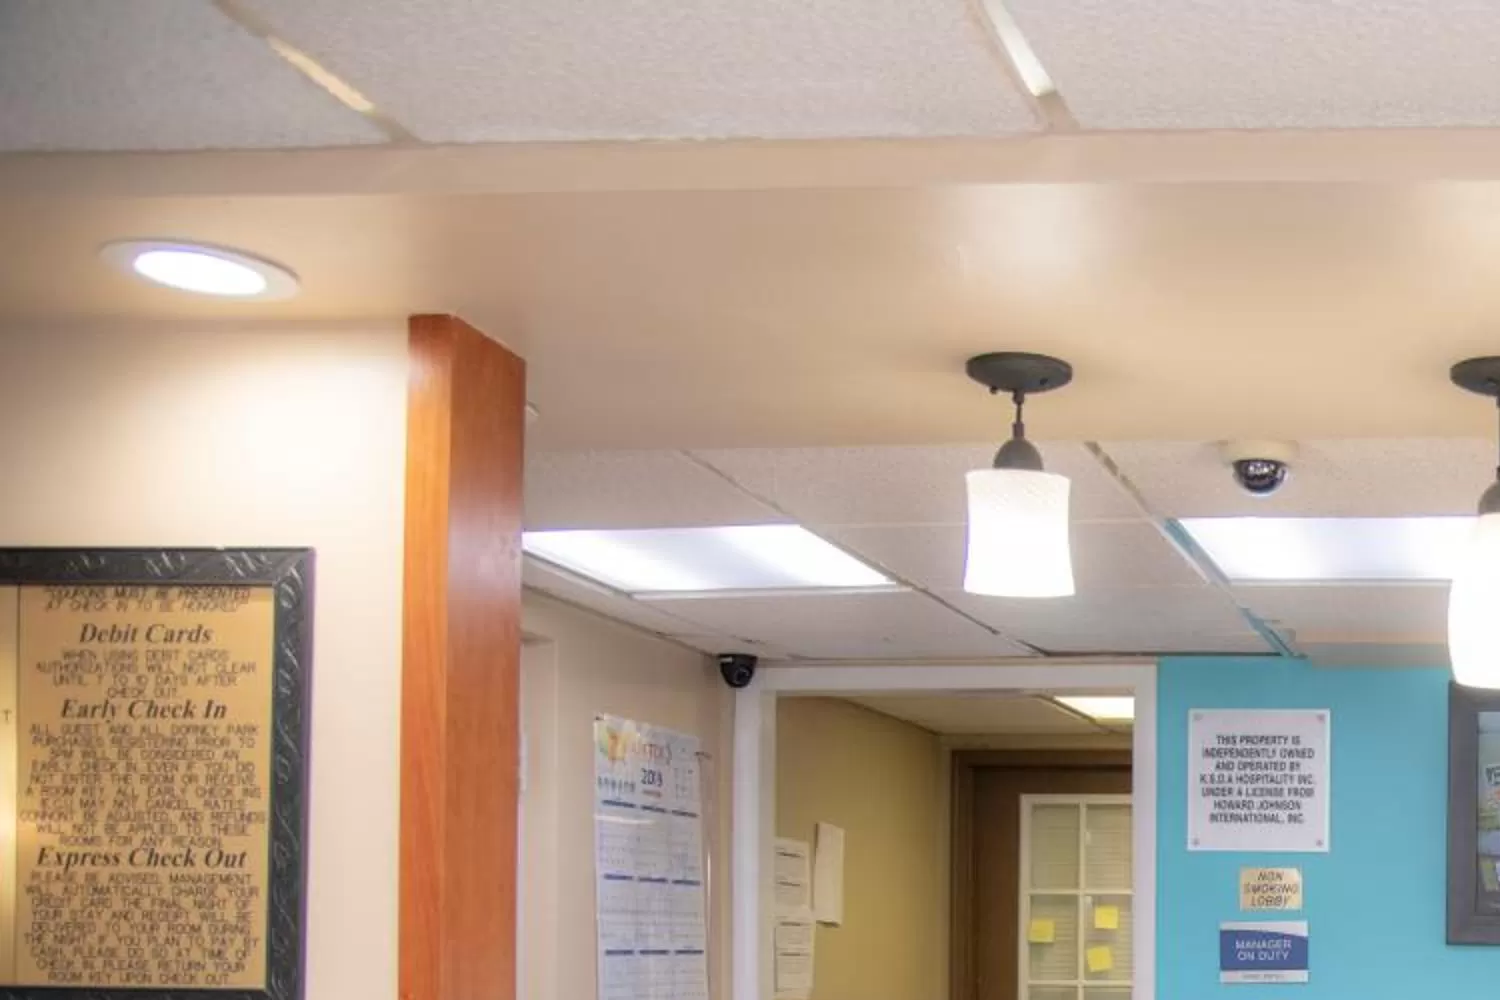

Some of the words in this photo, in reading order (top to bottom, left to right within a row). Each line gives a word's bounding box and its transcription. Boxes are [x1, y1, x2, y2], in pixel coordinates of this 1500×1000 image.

[79, 623, 137, 644] Debit
[145, 623, 214, 644] Cards
[61, 698, 116, 724] Early
[128, 698, 196, 719] Check
[204, 698, 228, 719] In
[1216, 735, 1238, 745] THIS
[1239, 735, 1288, 745] PROPERTY
[1291, 735, 1301, 746] IS
[1202, 748, 1278, 759] INDEPENDENTLY
[1280, 748, 1315, 759] OWNED
[1215, 761, 1235, 772] AND
[1237, 761, 1287, 772] OPERATED
[1289, 761, 1301, 772] BY
[1236, 773, 1294, 785] HOSPITALITY
[1201, 787, 1233, 798] UNDER
[1237, 787, 1246, 798] A
[1246, 787, 1284, 798] LICENSE
[1287, 787, 1315, 798] FROM
[1213, 800, 1255, 811] HOWARD
[1256, 800, 1302, 811] JOHNSON
[36, 846, 121, 875] Express
[128, 846, 196, 868] Check
[204, 847, 248, 869] Out
[1250, 895, 1292, 908] LOBBY
[1235, 939, 1292, 950] MANAGER
[1237, 950, 1255, 961] ON
[1258, 950, 1290, 961] DUTY
